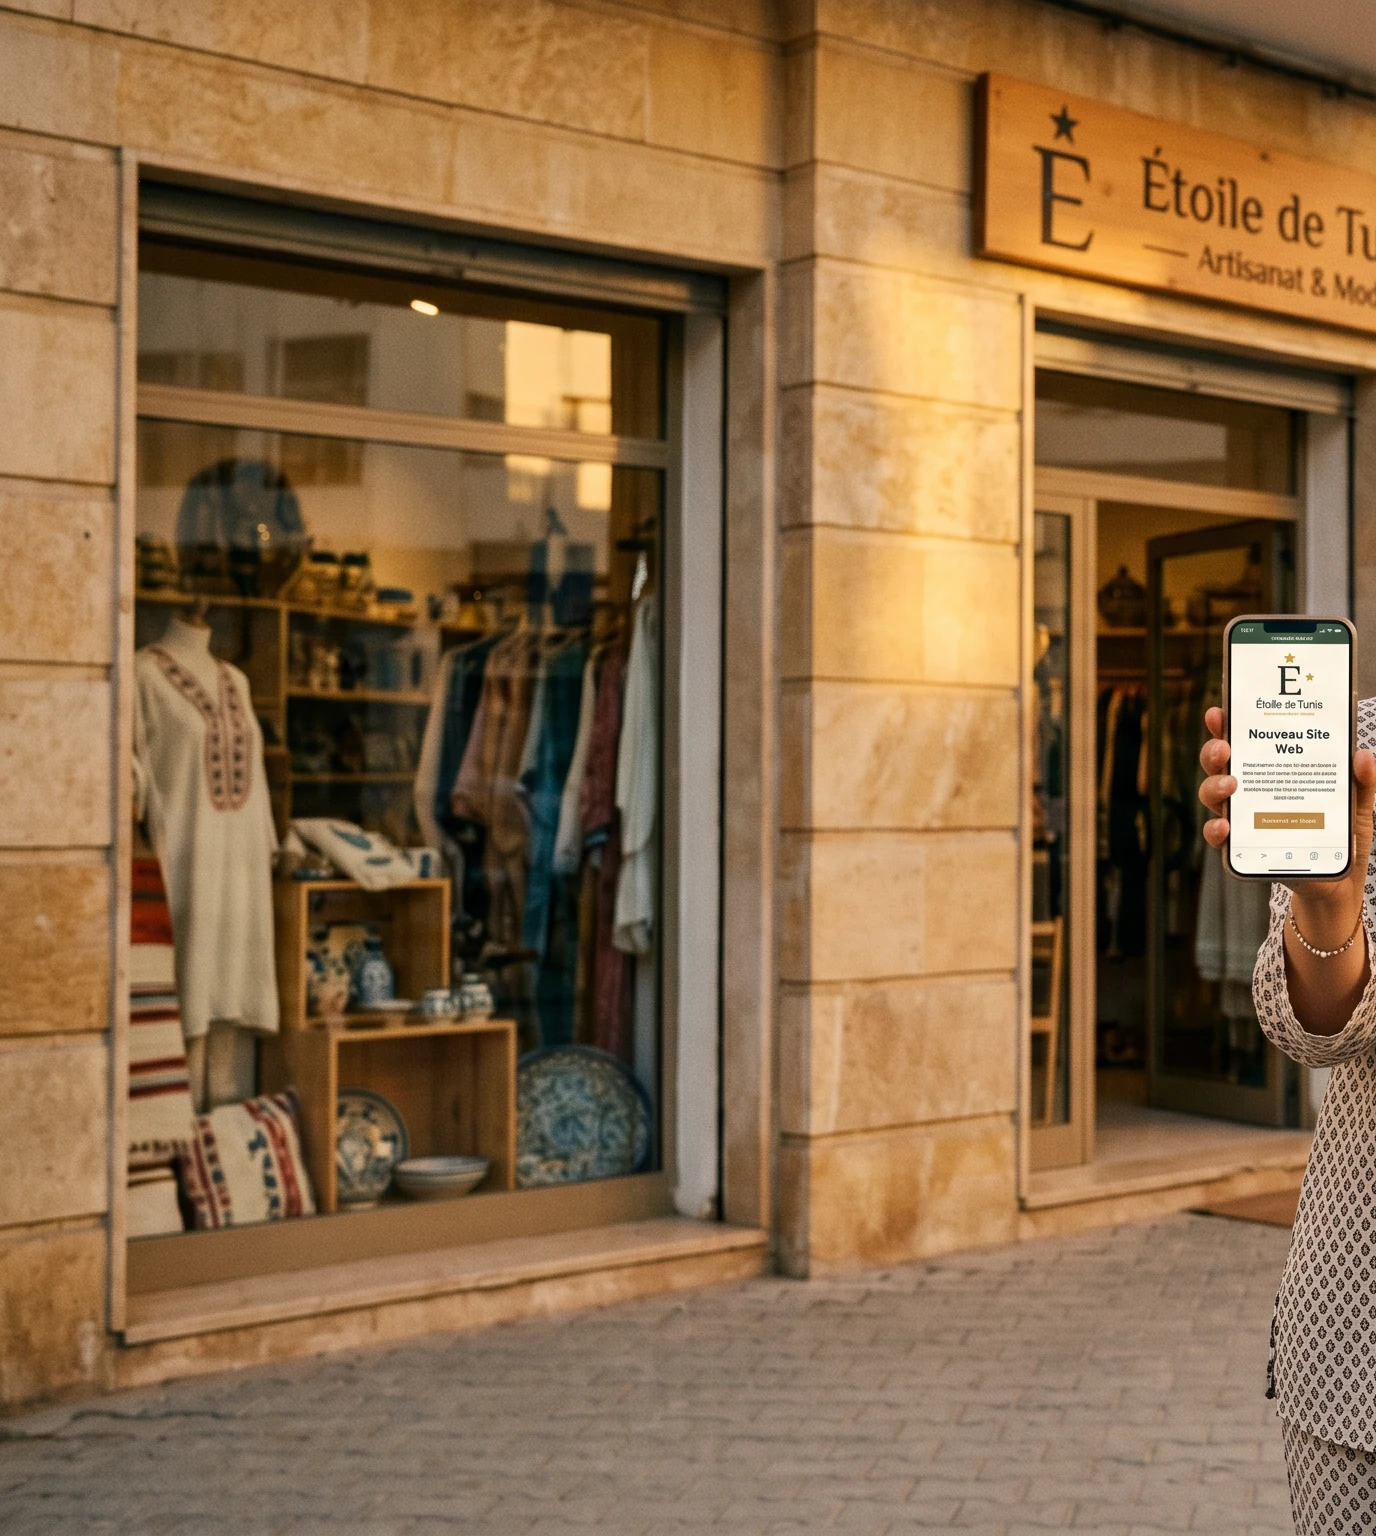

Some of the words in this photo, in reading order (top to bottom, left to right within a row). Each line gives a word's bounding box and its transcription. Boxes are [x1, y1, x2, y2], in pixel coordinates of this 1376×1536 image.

[1141, 146, 1263, 234] Étoile
[1278, 193, 1324, 248] de
[1198, 245, 1304, 293] Artisanat
[1311, 267, 1327, 297] &
[1284, 700, 1296, 709] de
[1297, 699, 1323, 709] Tunis
[1248, 728, 1303, 740] Nouveau
[1306, 728, 1331, 740] Site
[1275, 743, 1304, 754] Web
